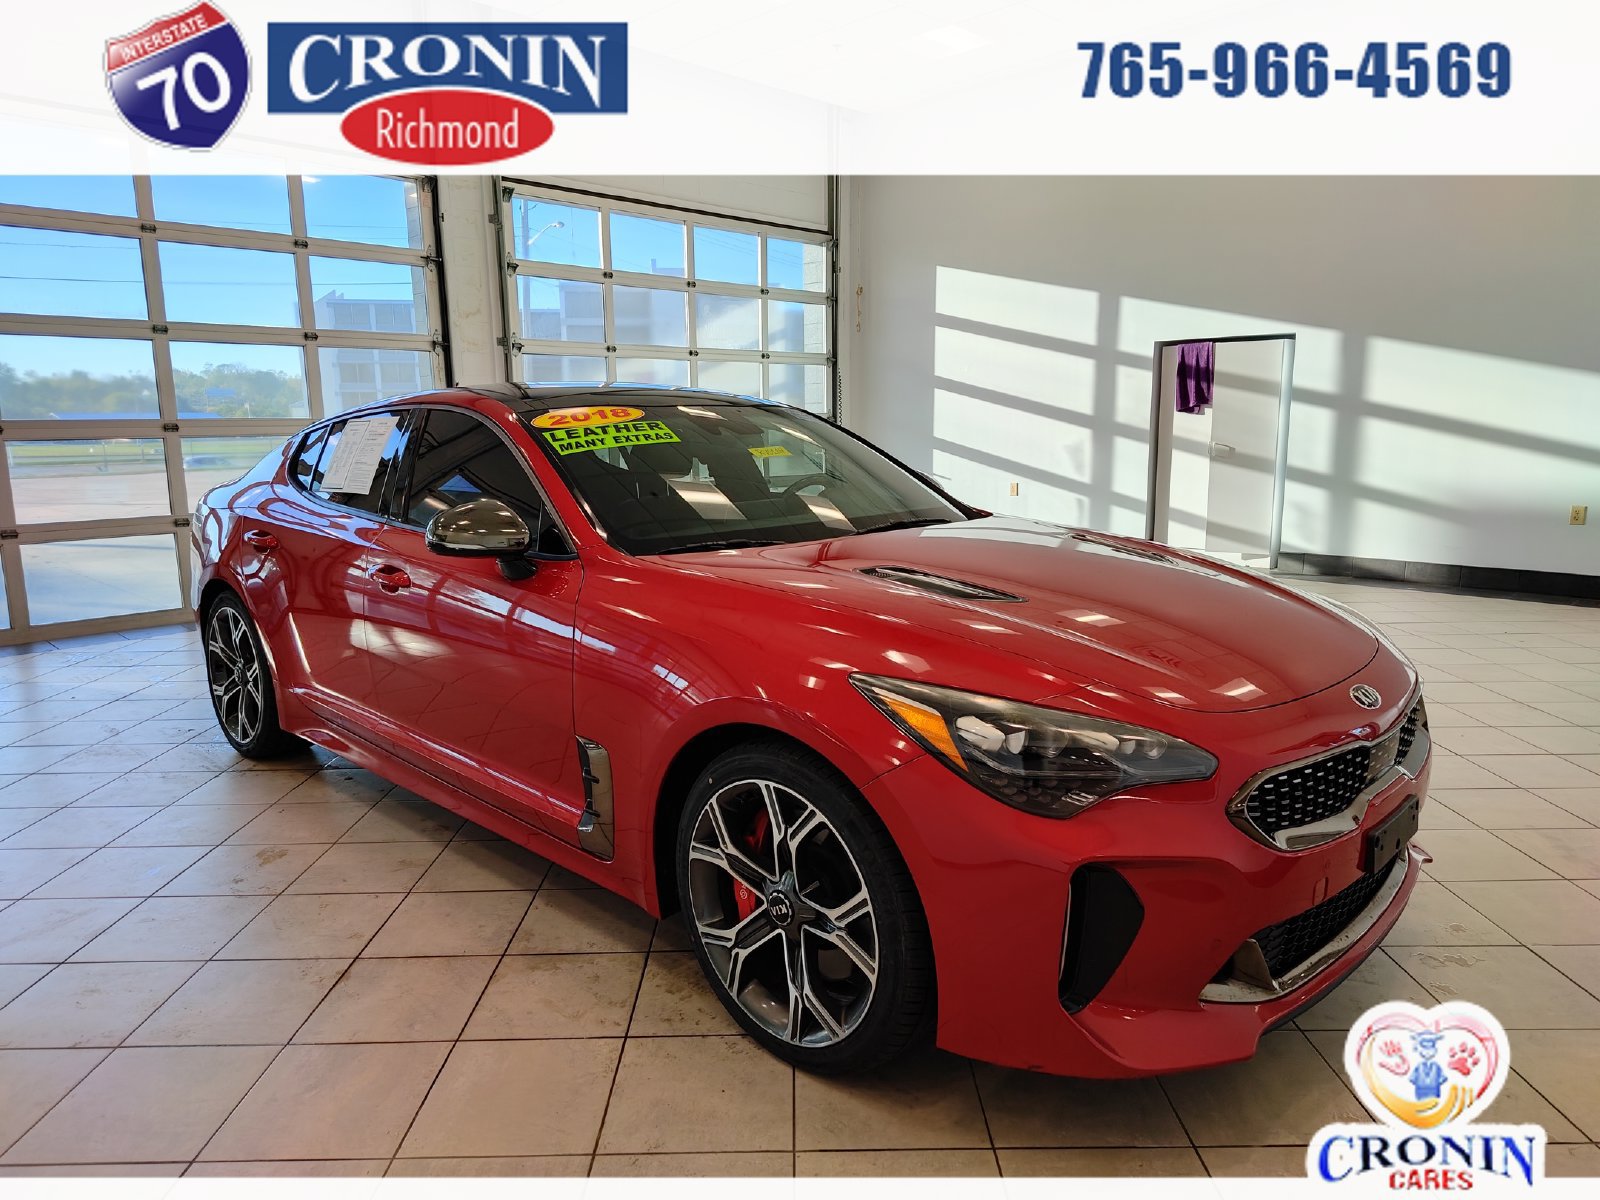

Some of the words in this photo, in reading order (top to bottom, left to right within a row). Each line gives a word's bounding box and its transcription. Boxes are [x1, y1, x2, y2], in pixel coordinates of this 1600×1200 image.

[549, 408, 631, 426] 2018
[550, 421, 664, 442] LEATHER
[558, 437, 606, 452] MANY
[613, 432, 673, 444] EXTRAS
[770, 904, 787, 916] KIA
